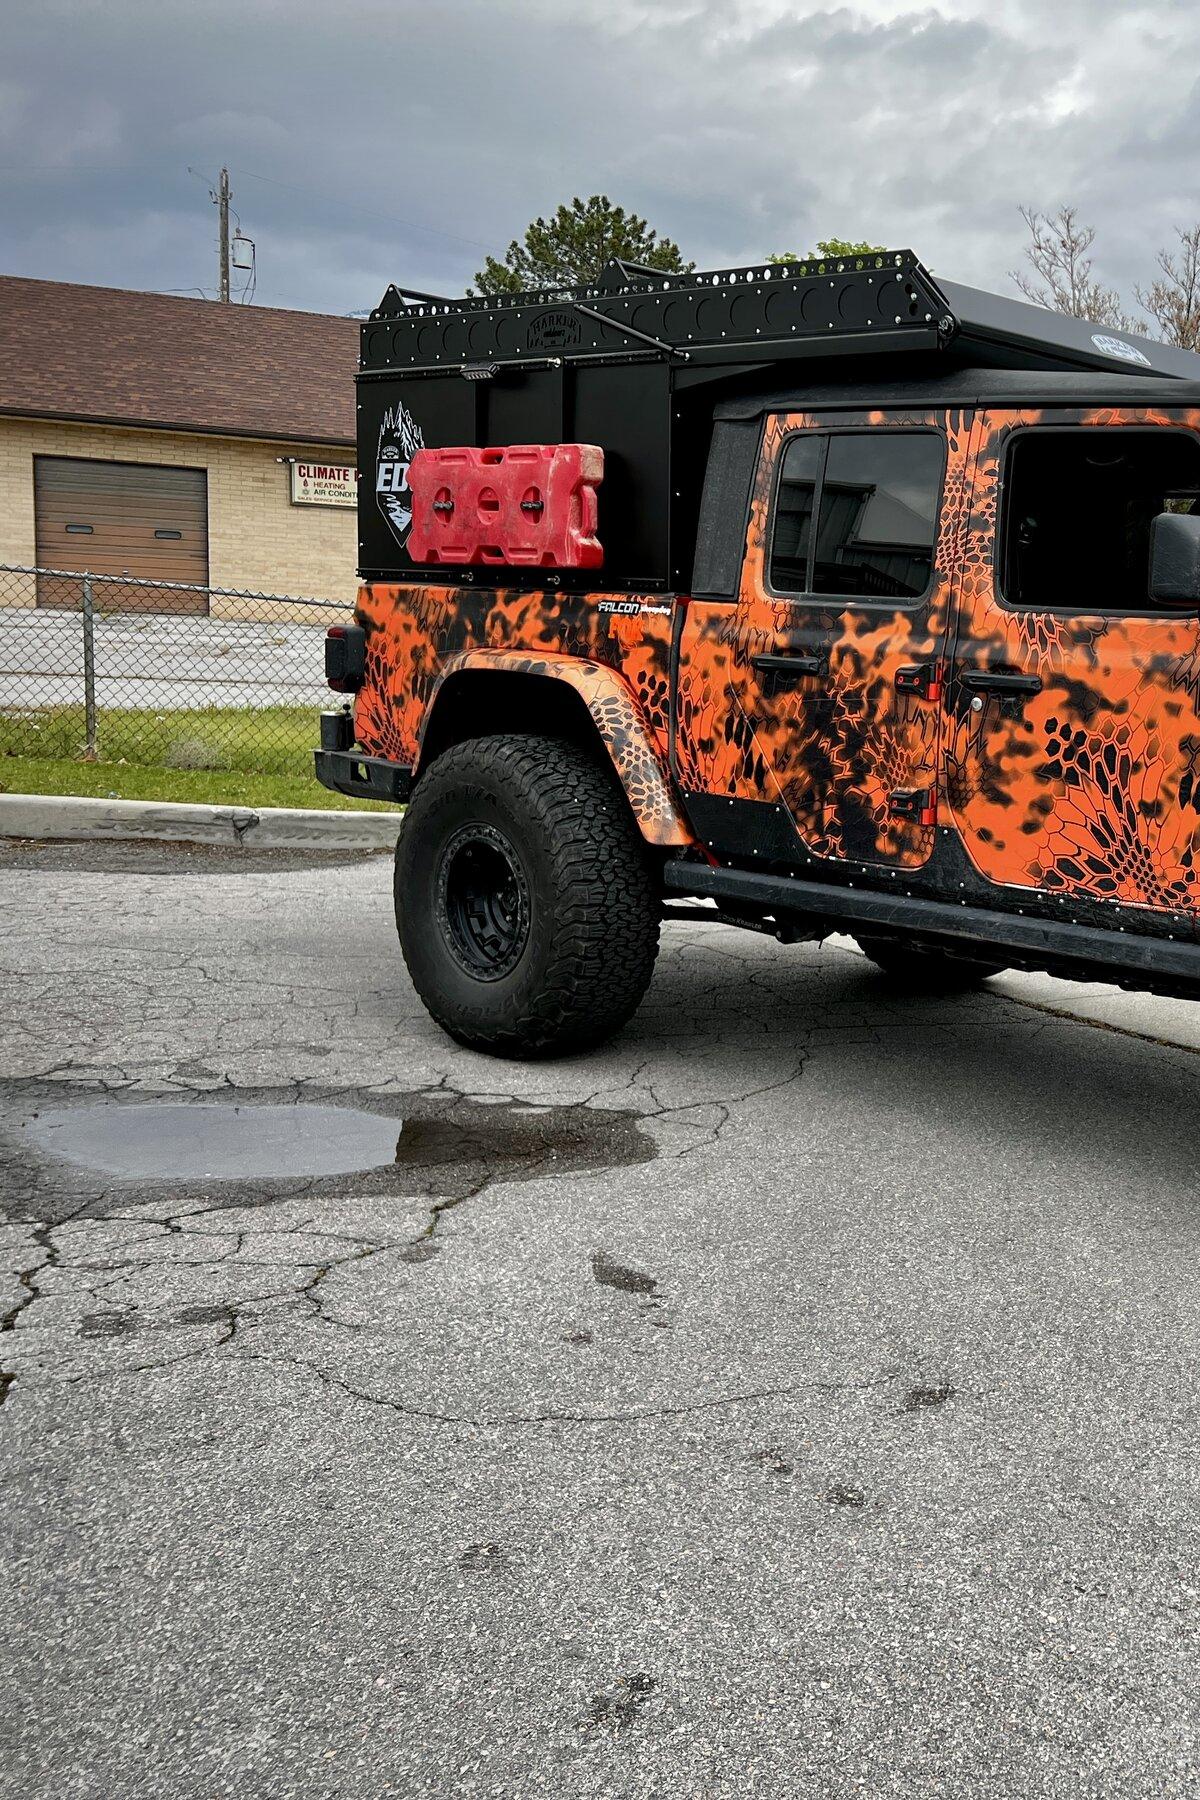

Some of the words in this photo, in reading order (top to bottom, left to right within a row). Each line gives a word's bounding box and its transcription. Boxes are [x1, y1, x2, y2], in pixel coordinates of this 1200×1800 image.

[298, 465, 349, 482] CLIMATE
[313, 481, 346, 490] HEATING
[597, 601, 640, 614] FALCON
